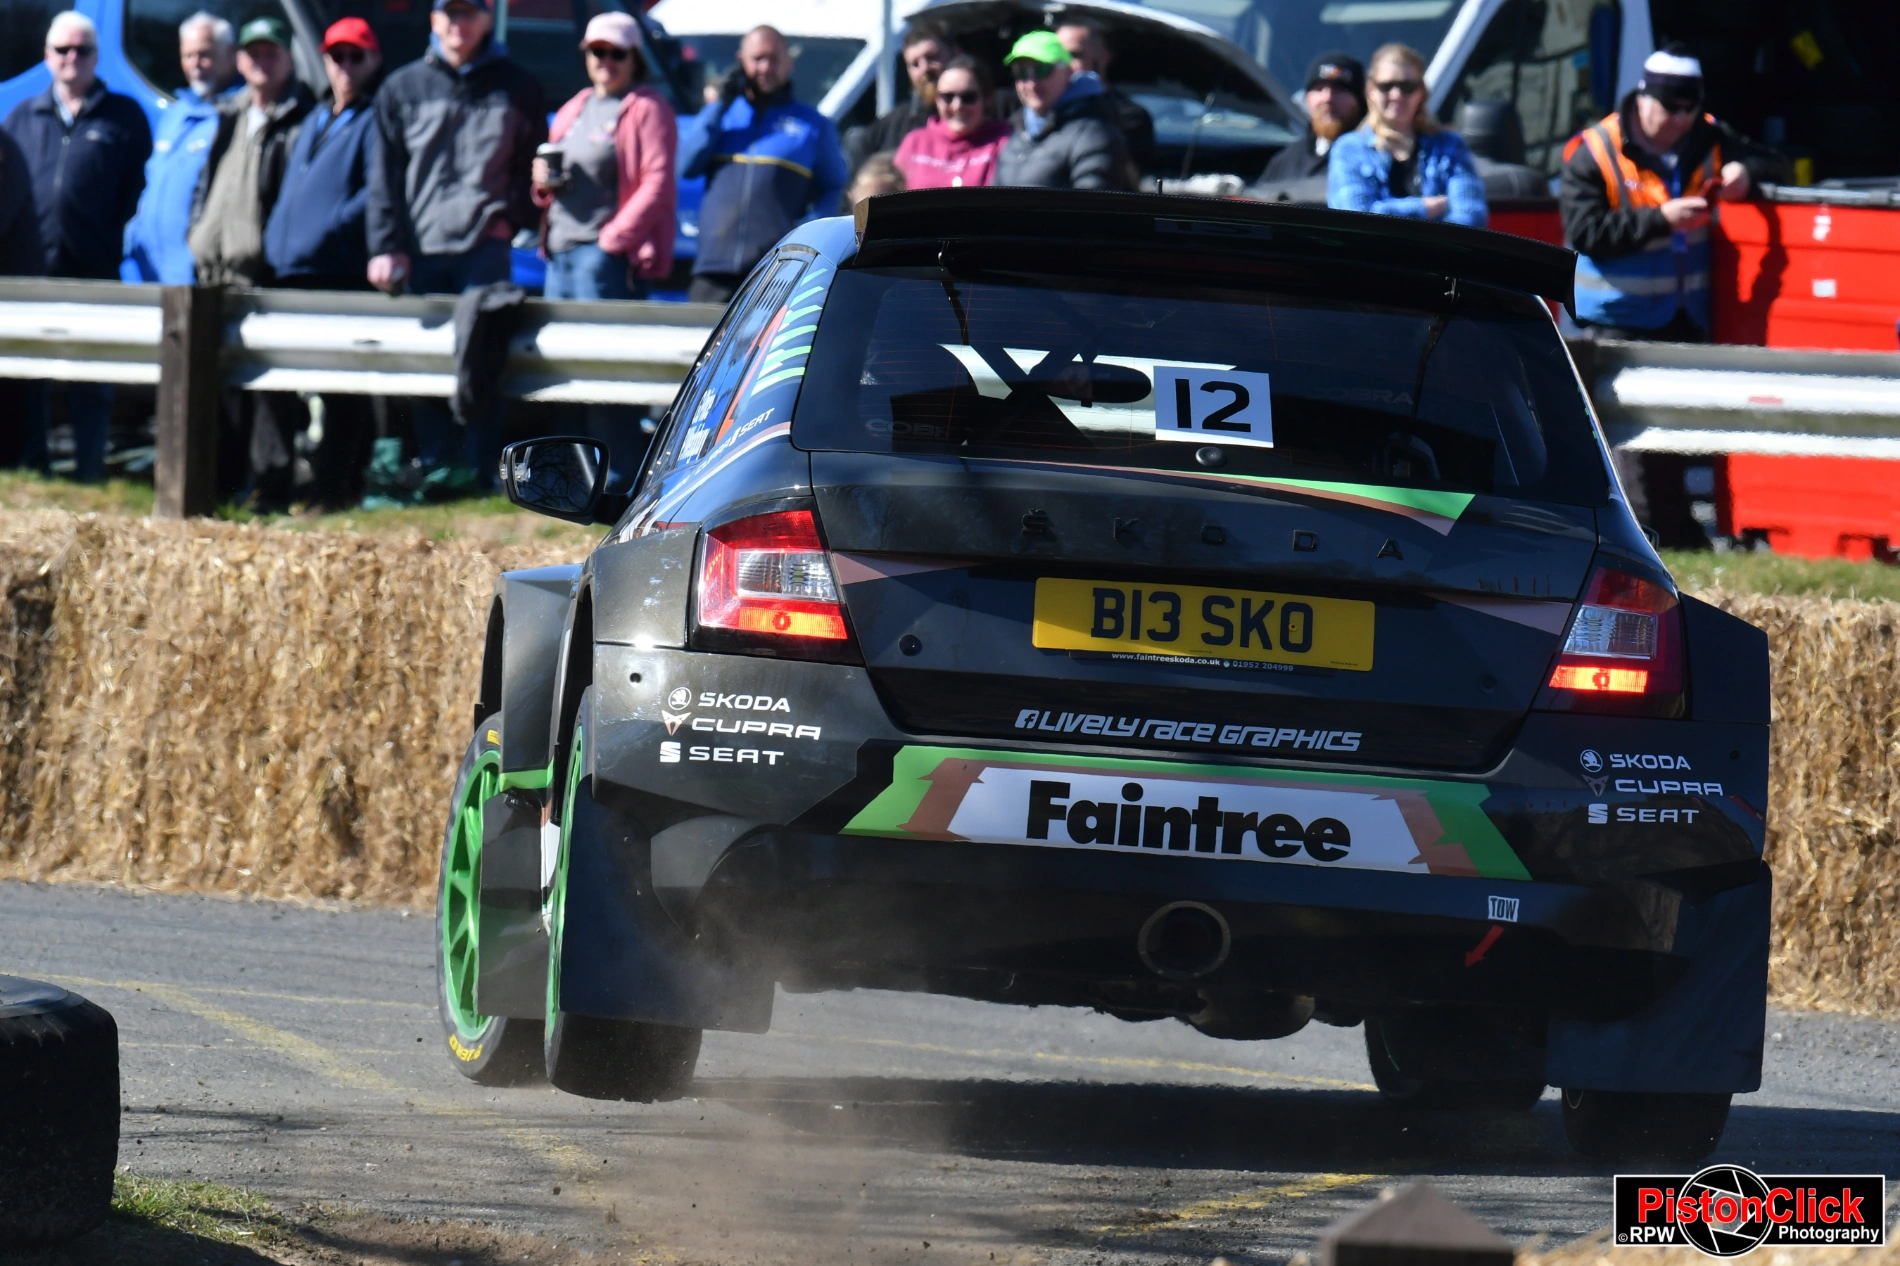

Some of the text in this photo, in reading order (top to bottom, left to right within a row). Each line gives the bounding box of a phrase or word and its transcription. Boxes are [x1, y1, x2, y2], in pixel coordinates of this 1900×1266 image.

[1174, 378, 1252, 433] 12
[738, 407, 775, 437] SEAT
[1091, 587, 1314, 654] B13 SKO
[1112, 653, 1294, 672] www.faintreeskoda.co.uk 01952 204999
[691, 717, 822, 741] CUPRA
[688, 746, 785, 766] SEAT
[1614, 779, 1724, 796] CUPRA
[1026, 779, 1352, 862] Faintree
[1616, 807, 1700, 824] SEAT
[1490, 897, 1517, 921] TOW
